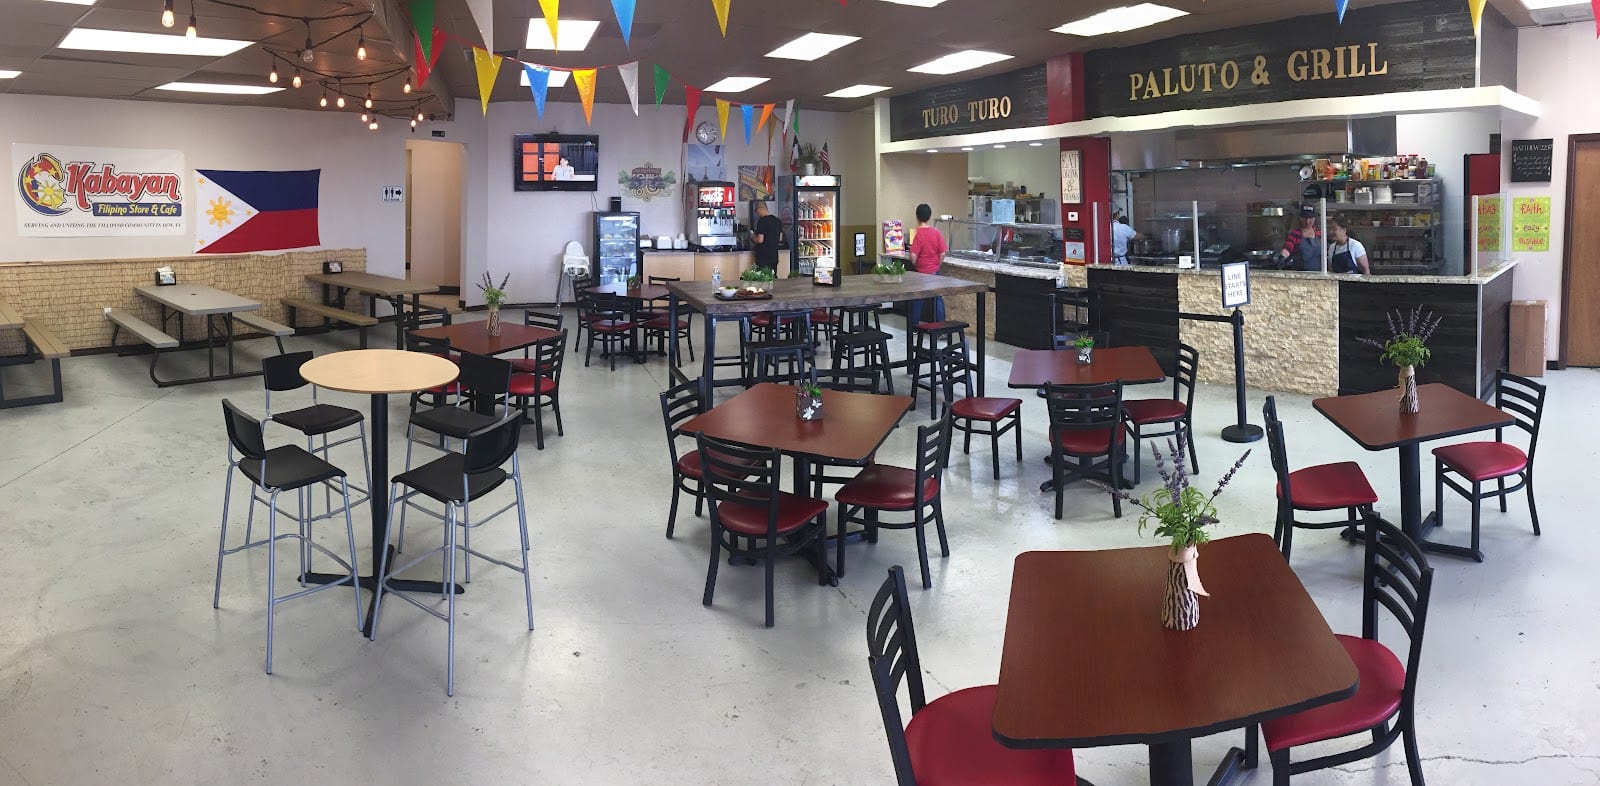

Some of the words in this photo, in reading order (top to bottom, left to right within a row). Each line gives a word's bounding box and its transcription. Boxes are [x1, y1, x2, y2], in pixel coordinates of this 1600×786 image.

[1129, 60, 1239, 101] PALUTO
[1251, 55, 1270, 86] &
[1287, 42, 1388, 82] GRILL
[922, 103, 959, 129] TURO
[967, 95, 1012, 122] TURO
[66, 162, 181, 211] Kabayan
[98, 203, 127, 216] Filipino
[129, 202, 149, 213] Store
[151, 203, 159, 215] &
[160, 203, 177, 215] Cafe
[1227, 272, 1242, 281] LINE
[1224, 280, 1247, 290] STARTS
[1227, 289, 1244, 299] HERE
